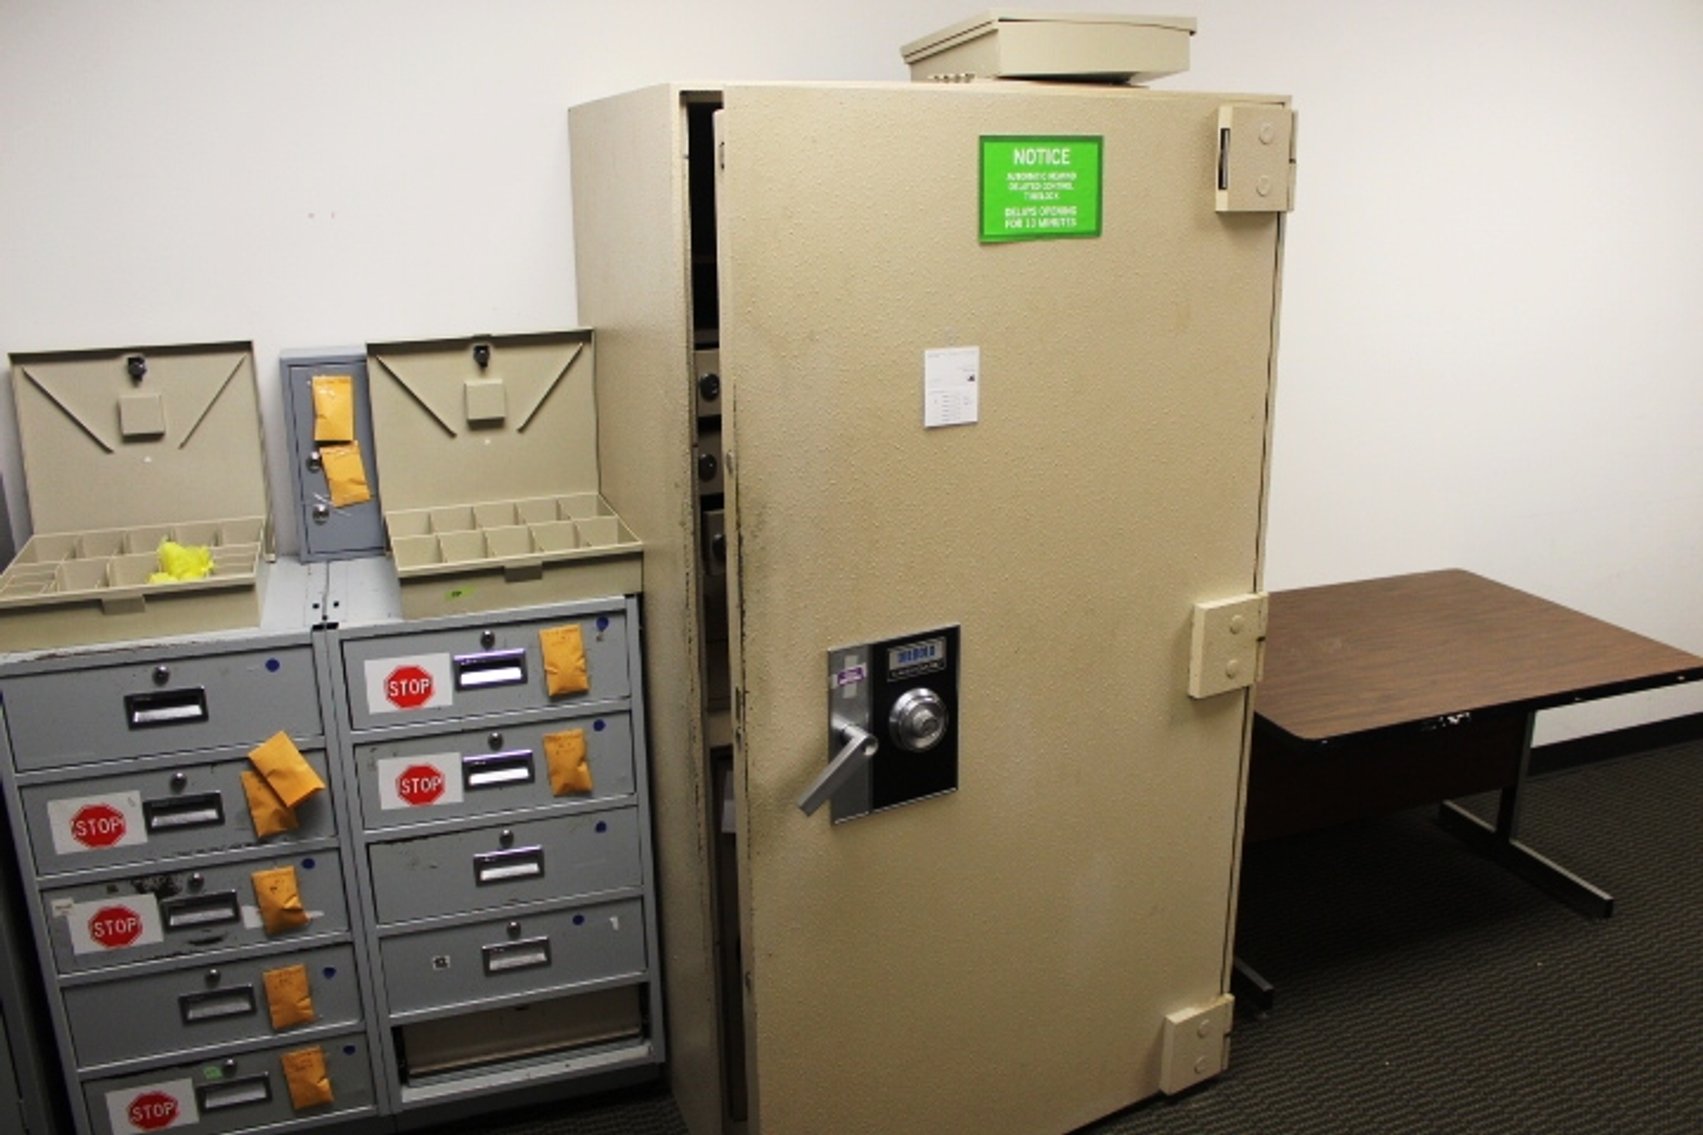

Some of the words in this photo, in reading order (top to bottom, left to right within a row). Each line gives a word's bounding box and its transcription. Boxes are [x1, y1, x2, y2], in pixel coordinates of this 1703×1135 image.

[1014, 147, 1071, 166] NOTICE
[1005, 218, 1022, 229] FOR
[388, 677, 431, 698] STOP
[400, 776, 442, 796] STOP
[74, 815, 123, 837] STOP
[93, 916, 138, 938] STOP
[131, 1100, 178, 1122] STOP
